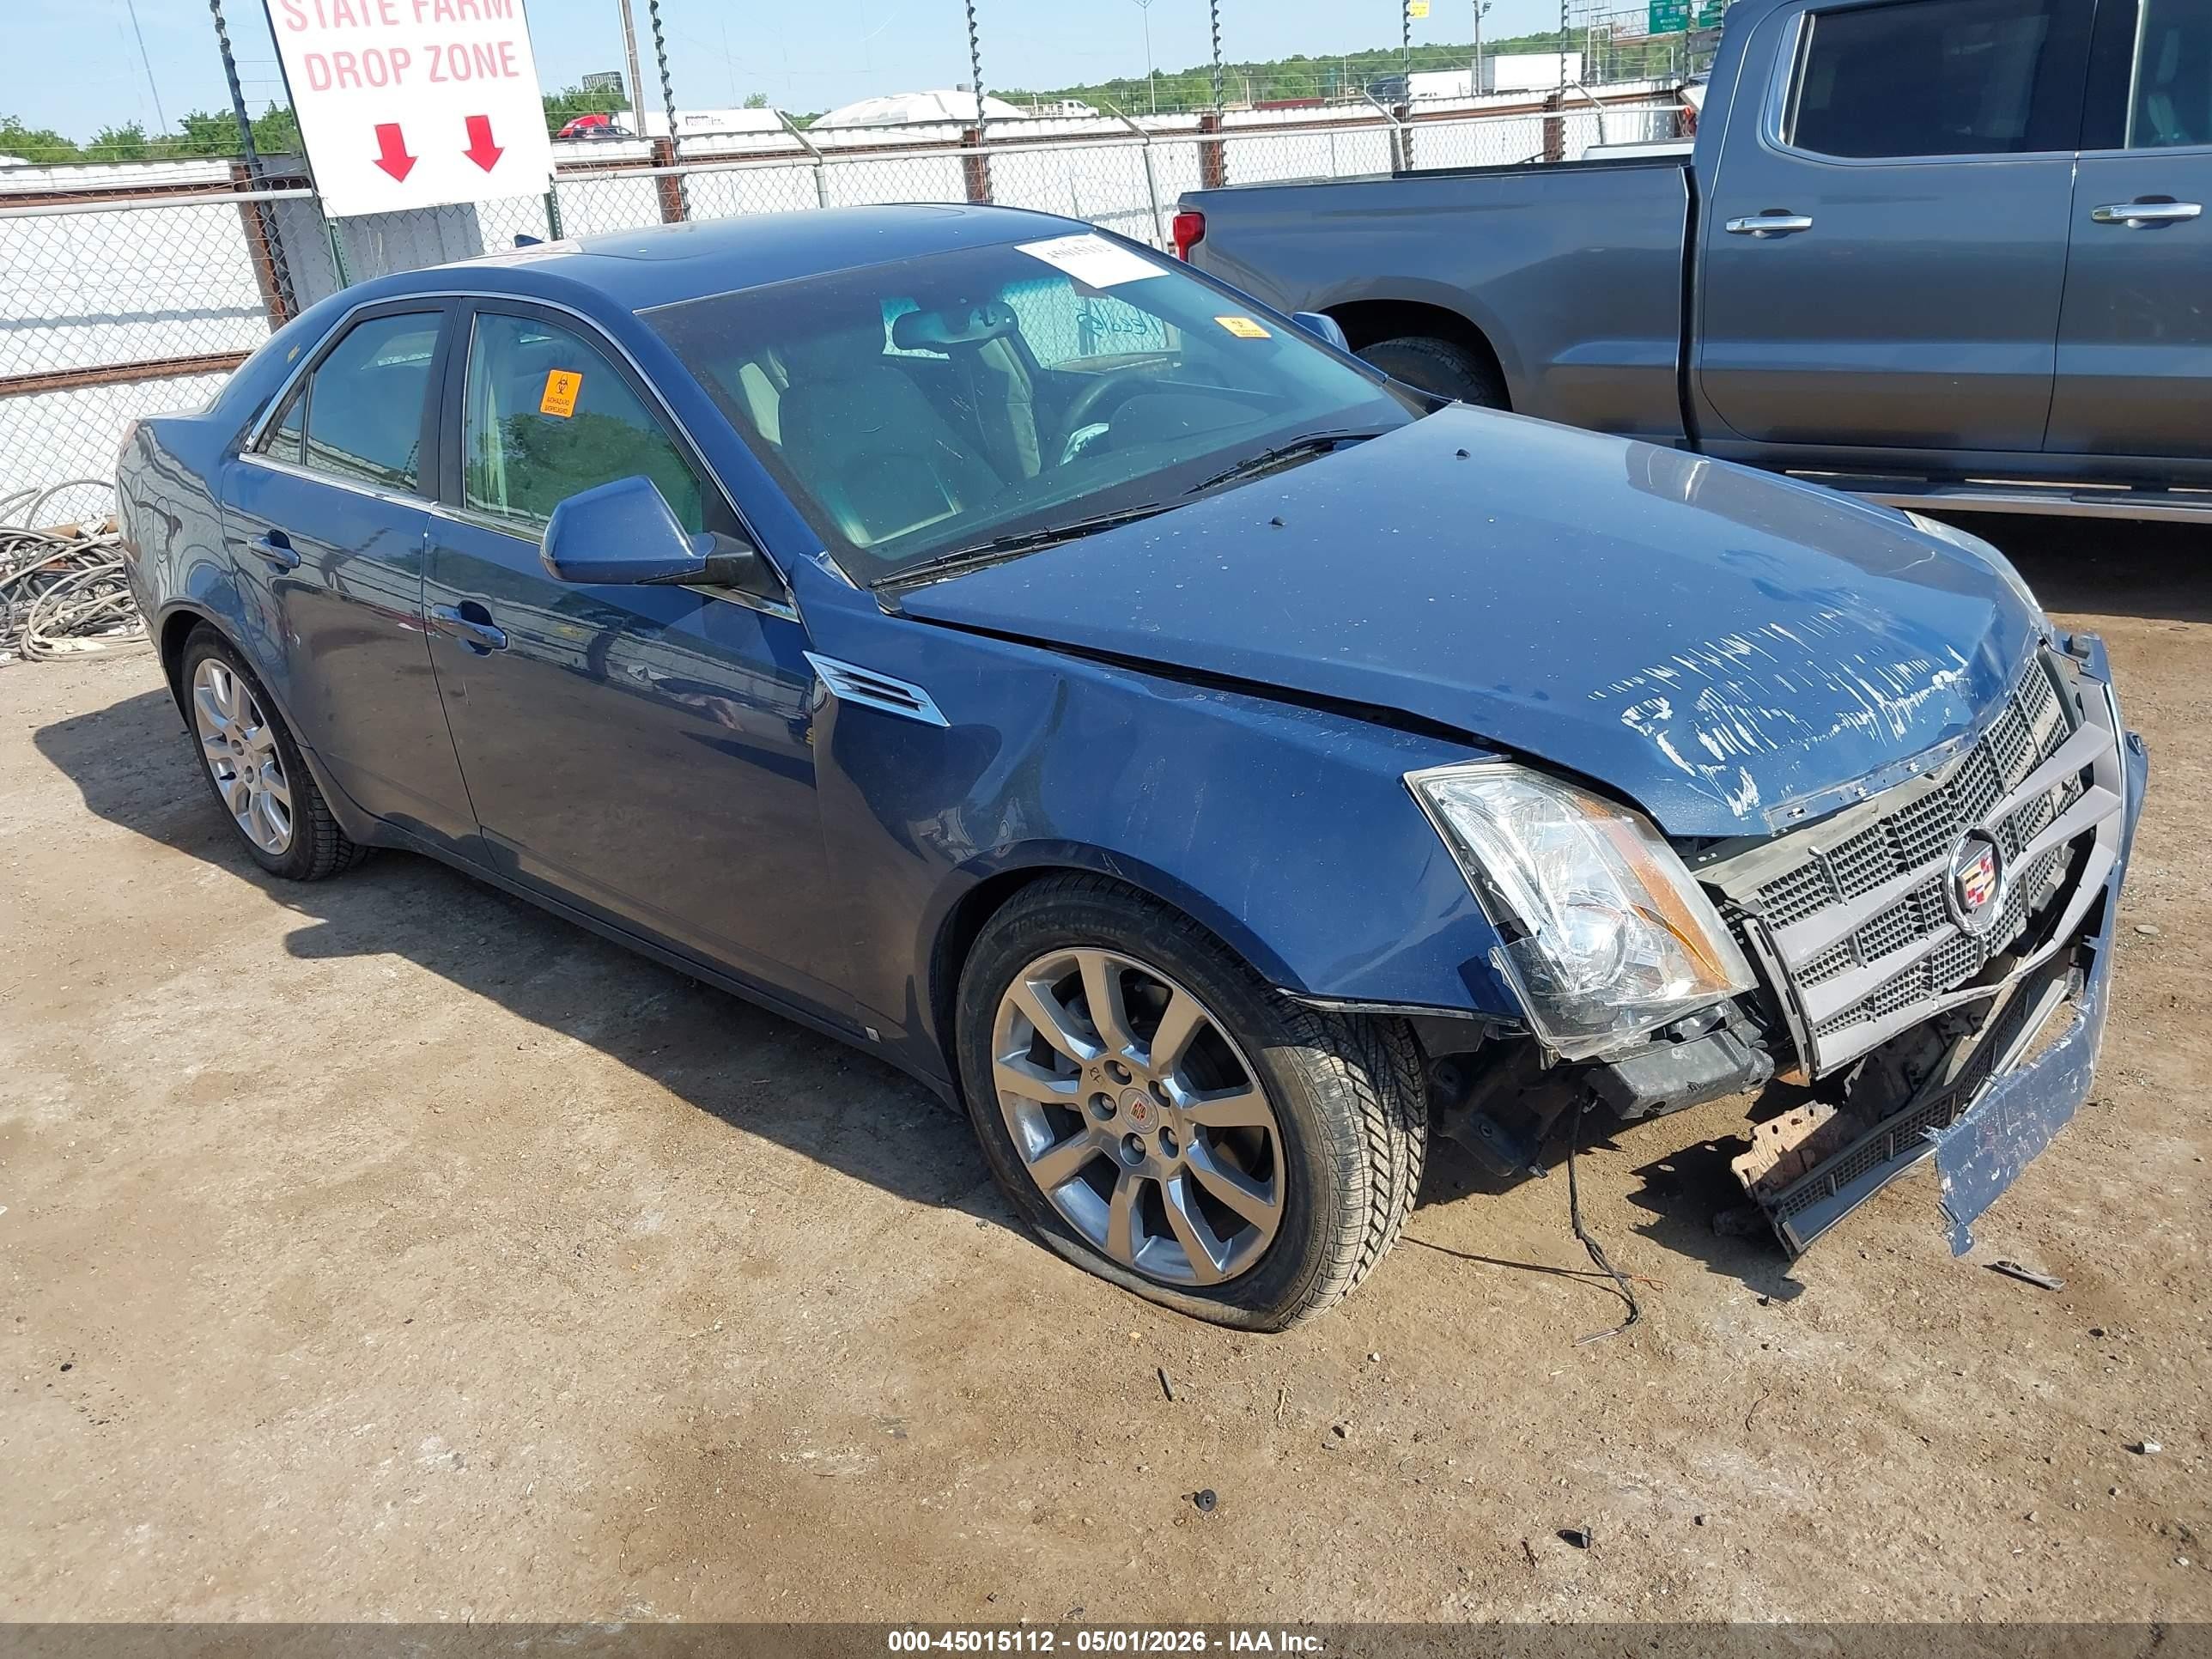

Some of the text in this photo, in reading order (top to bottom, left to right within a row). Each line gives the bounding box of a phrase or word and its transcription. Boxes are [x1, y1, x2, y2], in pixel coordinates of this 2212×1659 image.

[279, 0, 514, 32] STATE FARM
[304, 41, 520, 92] DROP ZONE
